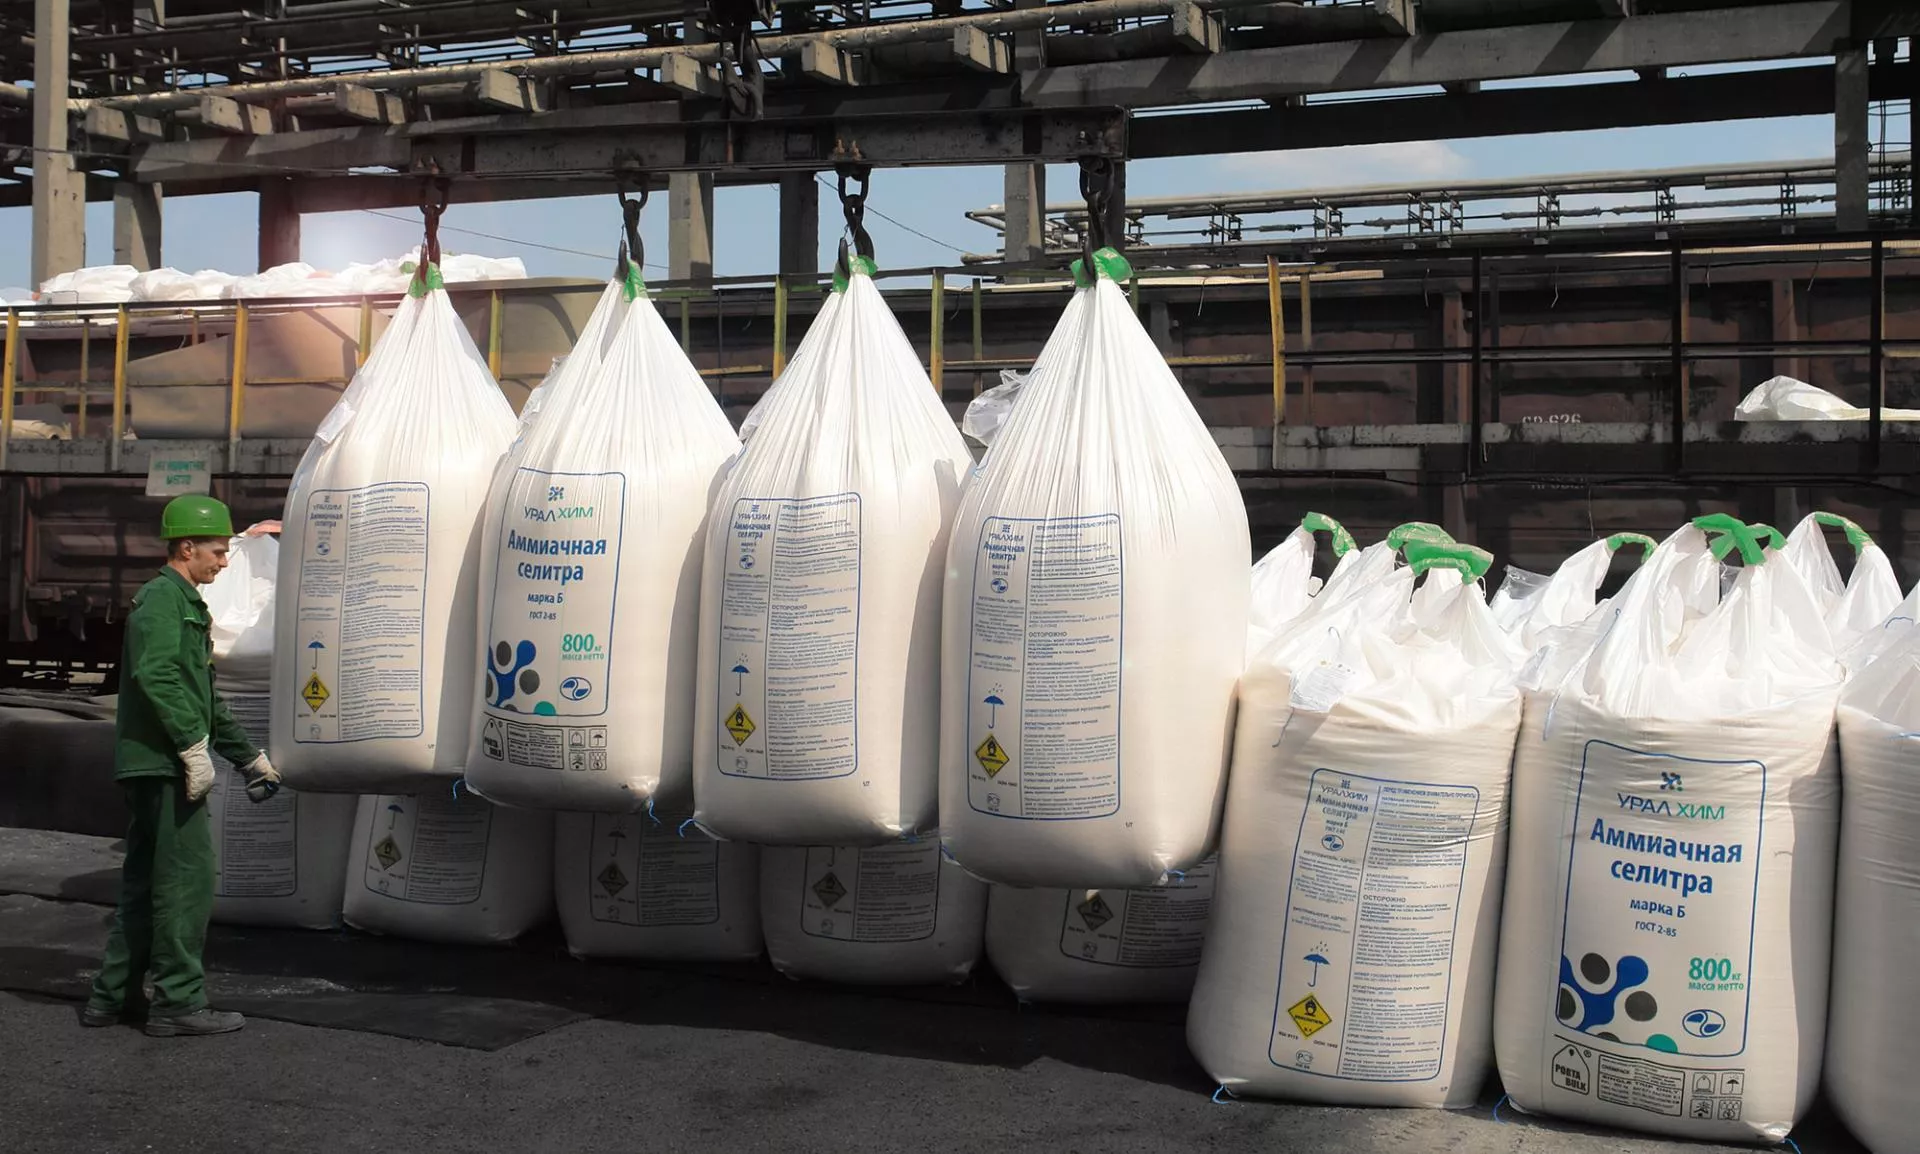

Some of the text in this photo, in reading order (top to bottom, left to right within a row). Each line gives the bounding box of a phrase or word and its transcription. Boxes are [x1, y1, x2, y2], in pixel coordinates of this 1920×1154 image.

[507, 529, 607, 555] Аммиачная
[518, 562, 584, 586] селитра
[527, 593, 564, 605] марка Б
[562, 633, 595, 652] 800
[1315, 794, 1369, 813] Аммиачная
[1590, 818, 1742, 864] Аммиачная
[1611, 859, 1713, 898] селитра
[1363, 894, 1406, 903] ОСТОРОЖНО
[1630, 899, 1685, 918] марка Б
[1635, 920, 1677, 937] ГОСТ 2-85
[1689, 957, 1732, 981] 800
[1688, 982, 1744, 991] масса нетто
[1555, 1063, 1581, 1080] PORTA
[1565, 1077, 1586, 1091] BULK
